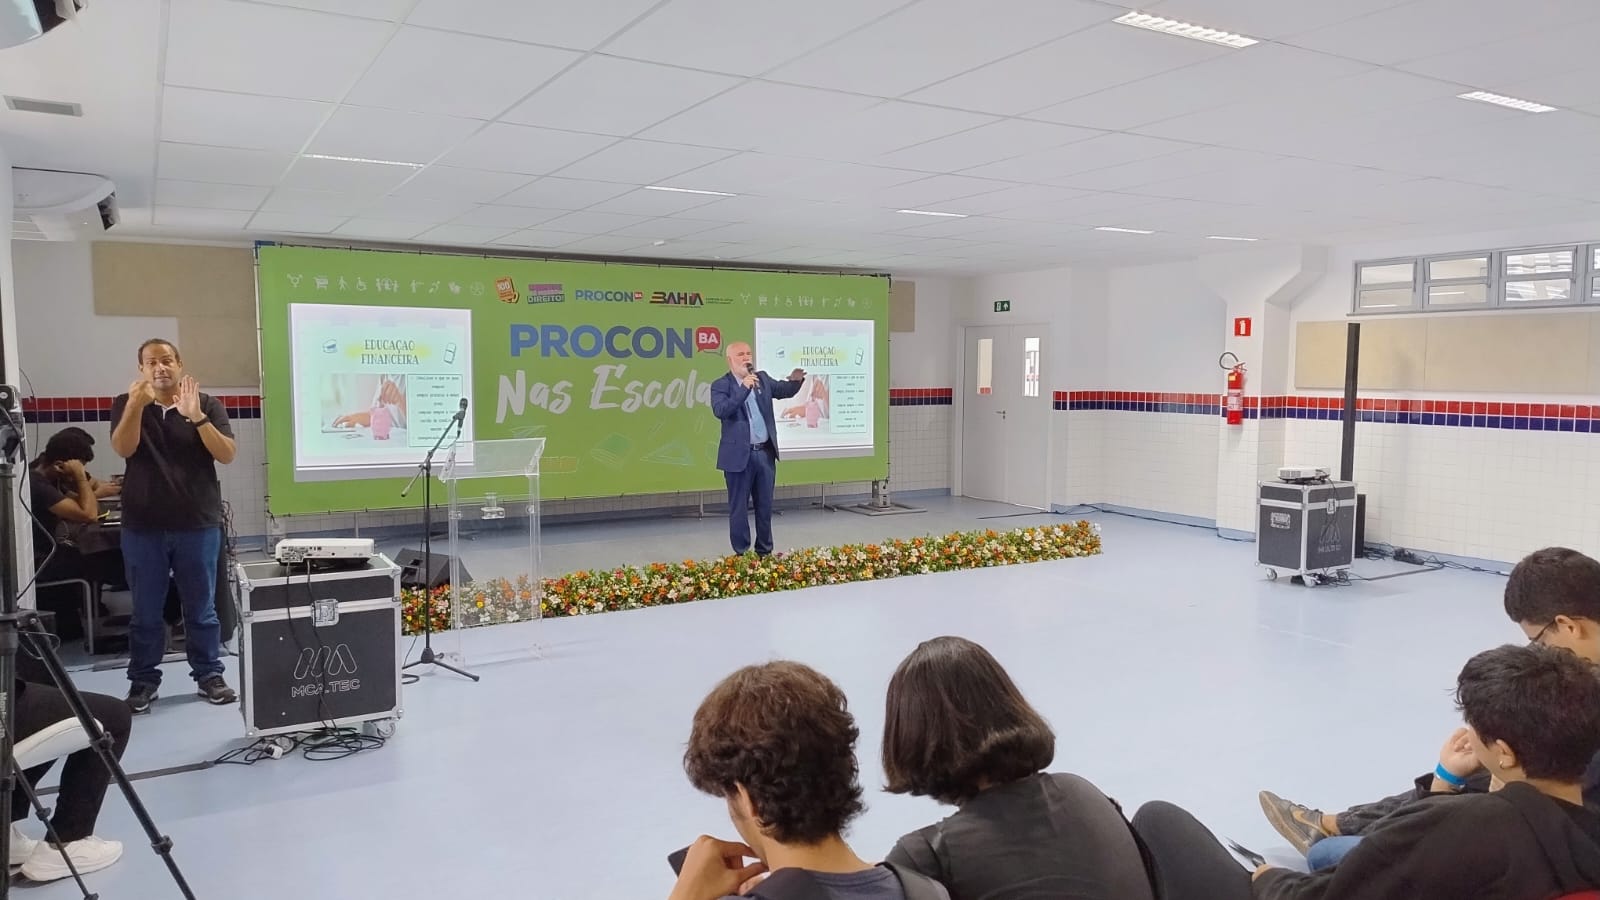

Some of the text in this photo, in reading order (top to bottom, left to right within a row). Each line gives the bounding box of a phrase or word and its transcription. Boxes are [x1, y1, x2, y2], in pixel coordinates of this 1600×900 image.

[575, 290, 633, 302] PROCON
[649, 291, 704, 305] BAHIA
[510, 323, 718, 358] PROCON BA
[361, 354, 419, 365] FINANCEIRA
[495, 363, 713, 424] Nas Escola
